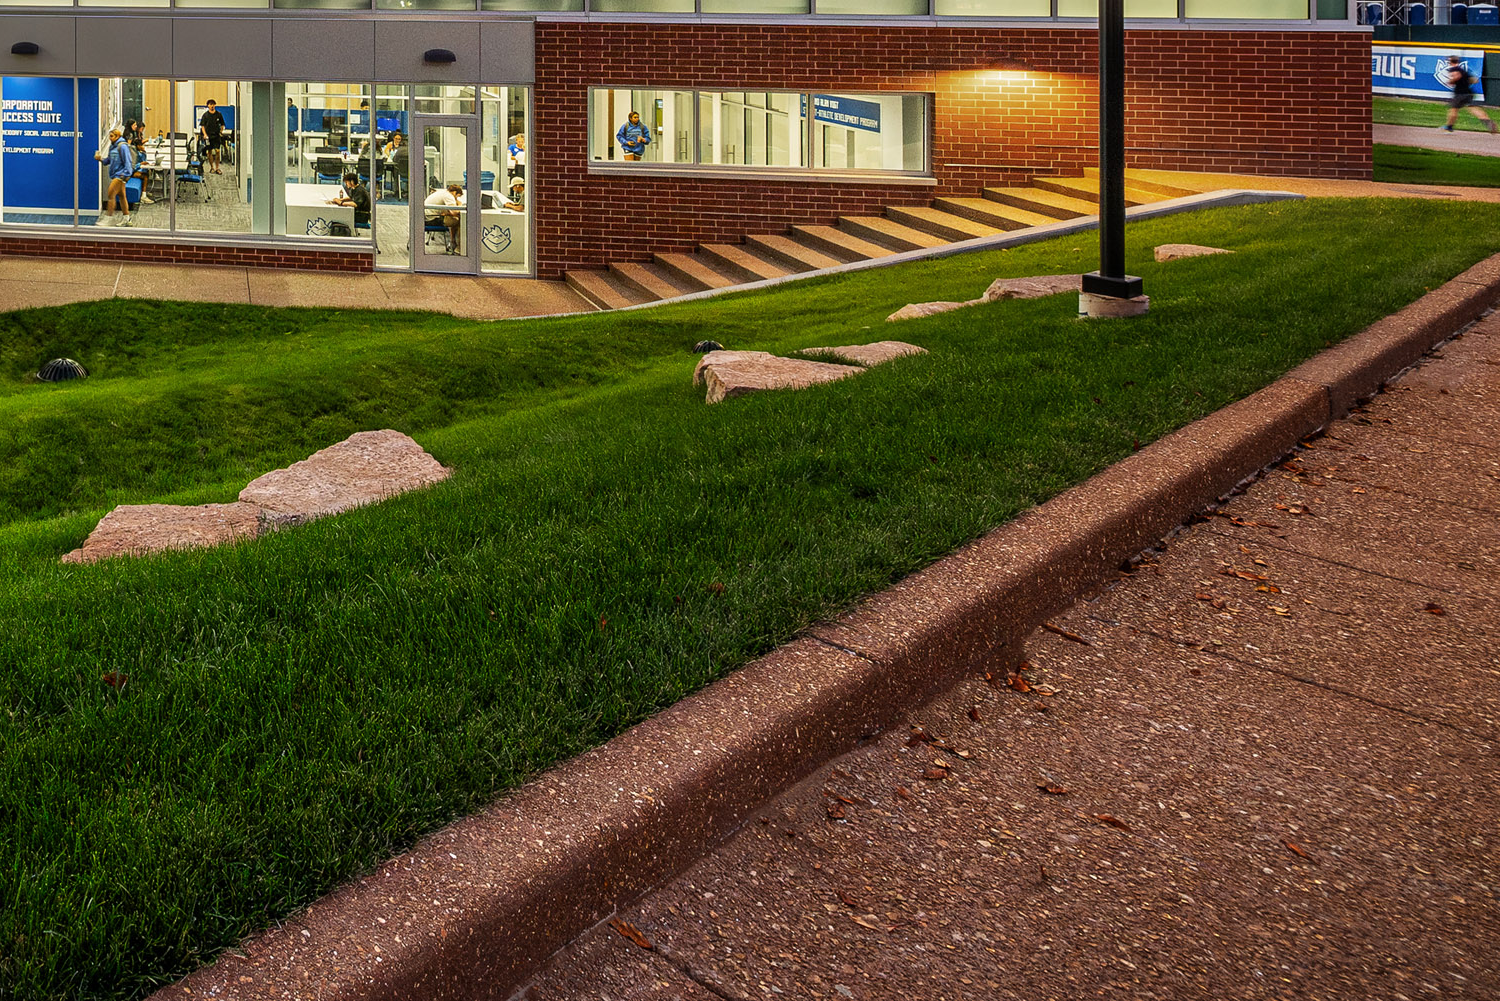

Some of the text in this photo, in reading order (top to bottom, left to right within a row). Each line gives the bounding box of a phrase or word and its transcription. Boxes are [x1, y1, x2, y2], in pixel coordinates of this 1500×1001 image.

[1372, 55, 1417, 80] OUIS
[2, 100, 53, 111] ORPORATION
[2, 112, 34, 123] UCCESS
[37, 112, 62, 123] SUITE
